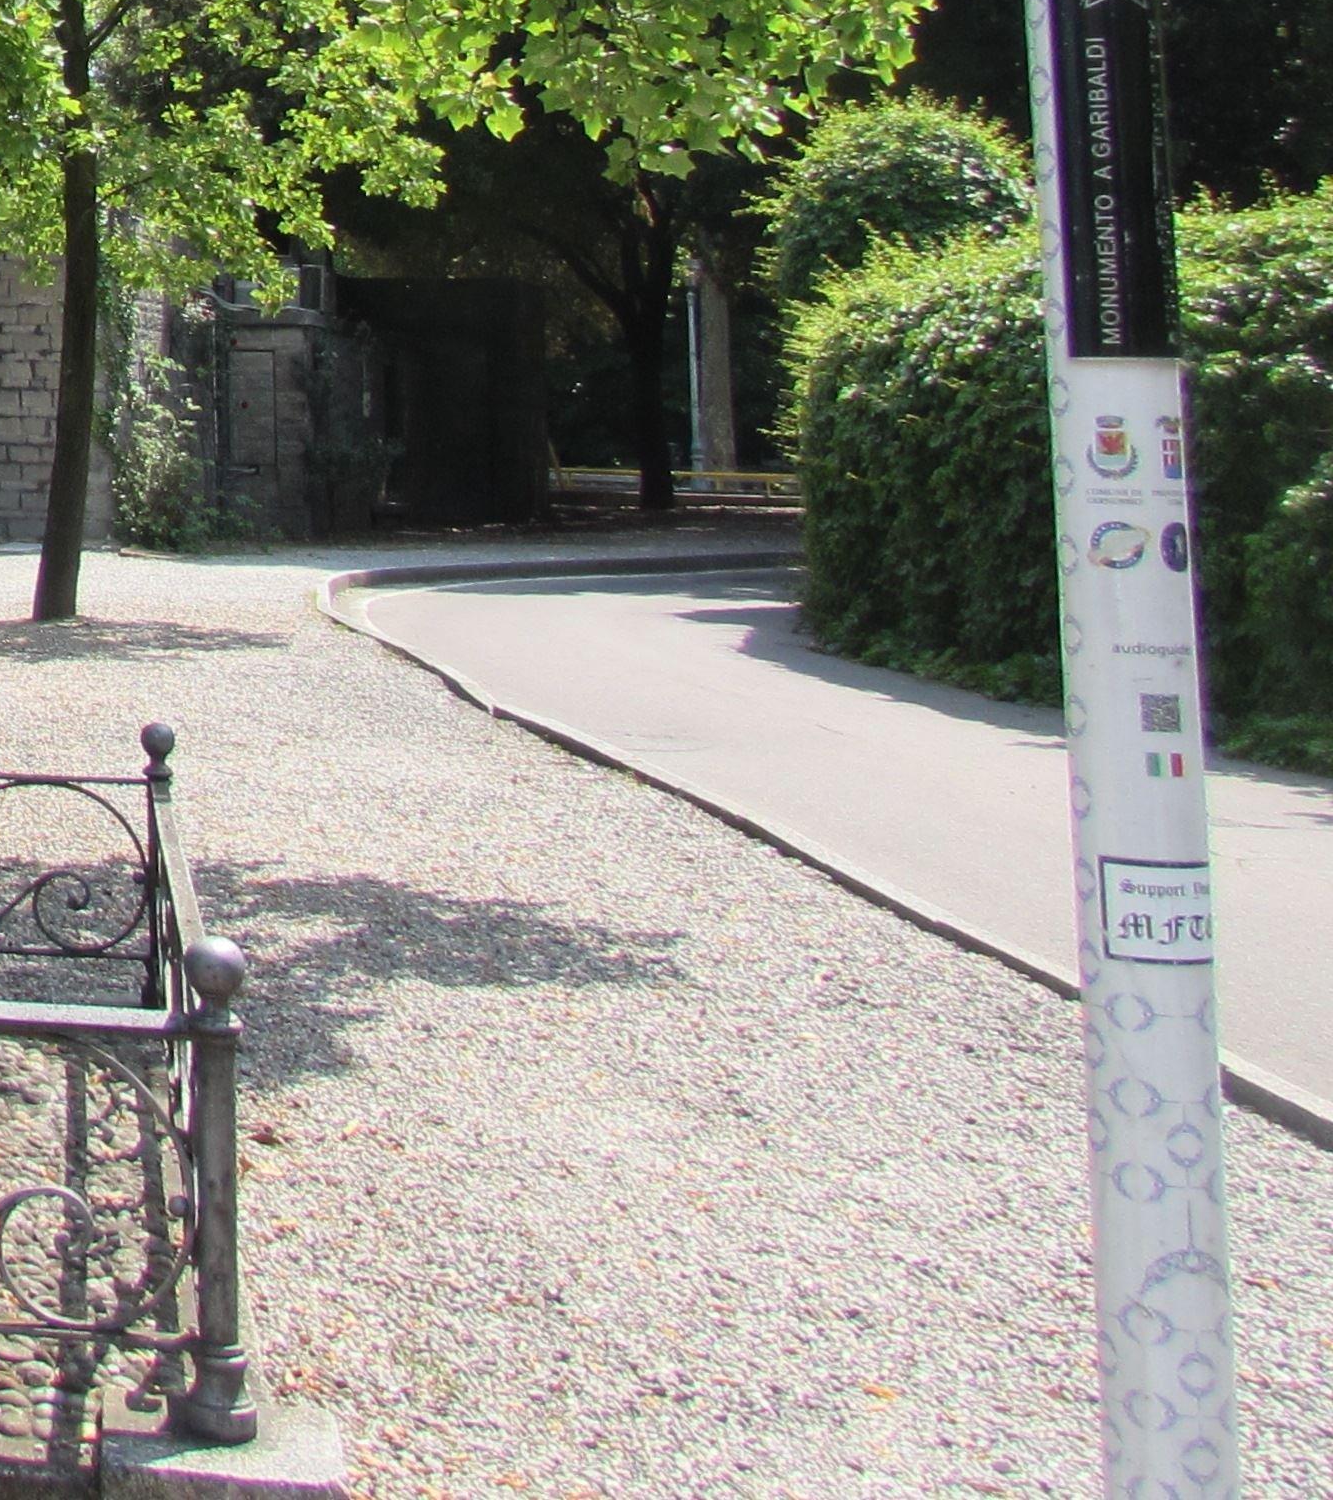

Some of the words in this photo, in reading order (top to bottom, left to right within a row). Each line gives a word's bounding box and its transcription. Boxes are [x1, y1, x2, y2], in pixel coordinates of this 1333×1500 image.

[1085, 37, 1112, 158] GARIBALDI
[1093, 165, 1113, 180] A
[1094, 194, 1121, 345] MONUMENTO
[1118, 877, 1186, 898] Support
